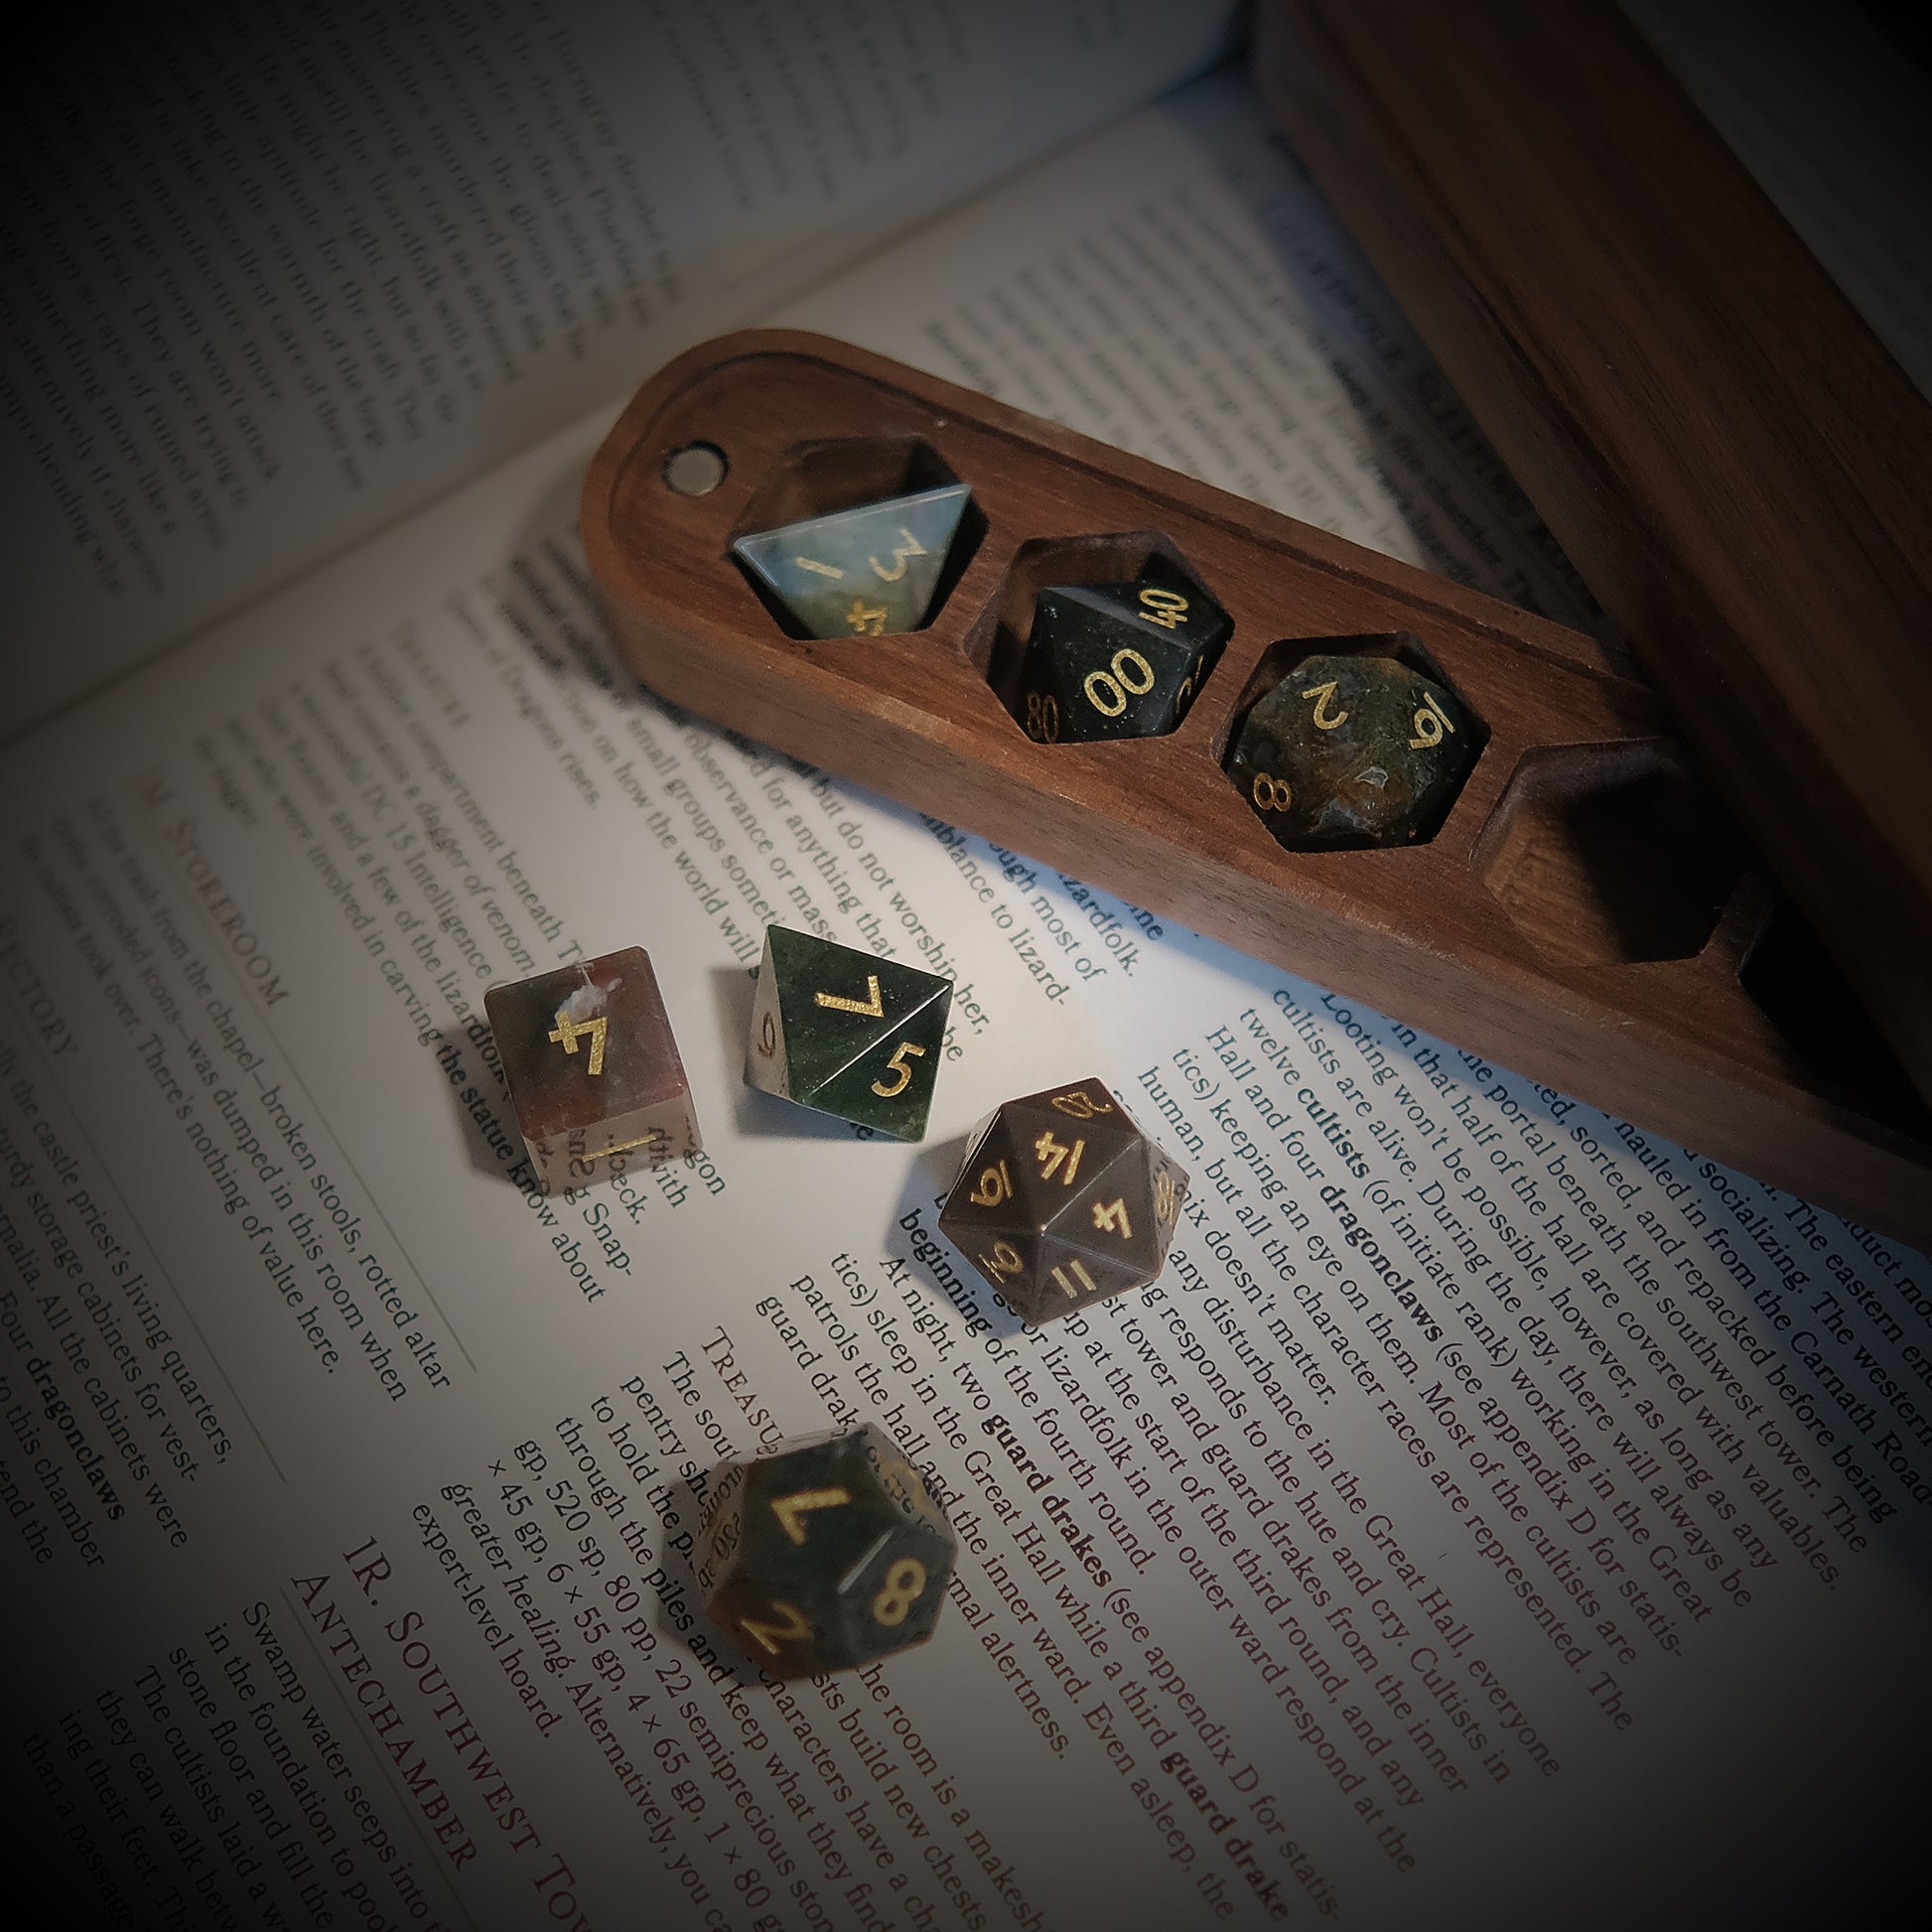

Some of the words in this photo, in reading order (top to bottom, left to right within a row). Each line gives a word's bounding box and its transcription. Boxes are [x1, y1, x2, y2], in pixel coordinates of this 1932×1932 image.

[795, 556, 843, 579] 1
[869, 527, 926, 582] 3
[847, 598, 888, 636] 4
[1138, 588, 1188, 629] 40
[1027, 691, 1059, 743] 80
[1084, 648, 1155, 717] 00
[1302, 681, 1348, 730] 2
[1254, 771, 1291, 811] 8
[990, 902, 1015, 930] to
[1007, 926, 1071, 1007] lizard-
[1029, 895, 1082, 956] most
[1073, 956, 1109, 983] of
[548, 1011, 609, 1075] 4
[813, 975, 885, 1019] 7
[953, 982, 991, 1035] her,
[871, 1041, 925, 1098] 5
[1050, 1091, 1114, 1120] 20
[379, 959, 445, 1047] carving
[435, 1043, 467, 1087] the
[455, 1086, 515, 1162] statue
[504, 1161, 561, 1228] know
[550, 1232, 608, 1305] about
[583, 1134, 658, 1163] 1
[1035, 1131, 1085, 1185] 14
[1092, 1197, 1133, 1239] 4
[1204, 1025, 1257, 1082] Hall
[1244, 1084, 1294, 1132] and
[1279, 1129, 1326, 1181] four
[1318, 1184, 1446, 1343] dragonclaws
[1435, 1341, 1483, 1396] (see
[1239, 1008, 1302, 1086] twelve
[1297, 1087, 1371, 1180] cultists
[1361, 1178, 1407, 1215] (of
[1389, 1211, 1461, 1301] initiate
[1453, 1301, 1519, 1368] rank)
[185, 1121, 251, 1216] nothing
[240, 1214, 275, 1241] of
[258, 1239, 305, 1309] value
[295, 1305, 340, 1375] here.
[310, 1173, 362, 1254] stools,
[356, 1253, 420, 1331] rotted
[404, 1330, 452, 1390] altar
[581, 1201, 632, 1277] Snap-
[1050, 1259, 1098, 1300] 11
[1393, 1082, 1450, 1152] won't
[1441, 1146, 1472, 1184] be
[1459, 1184, 1550, 1292] possible,
[1547, 1285, 1638, 1400] however,
[1697, 1162, 1812, 1296] socializing.
[1809, 1290, 1856, 1346] The
[32, 1121, 79, 1188] castle
[65, 1188, 130, 1278] priest's
[120, 1273, 174, 1351] living
[160, 1349, 232, 1465] quarters,
[1481, 1083, 1558, 1159] portal
[1545, 1153, 1629, 1256] beneath
[1621, 1253, 1661, 1297] the
[1654, 1297, 1765, 1422] southwest
[1756, 1419, 1823, 1499] tower.
[1821, 1493, 1868, 1554] The
[1679, 1197, 1708, 1231] in
[1702, 1226, 1757, 1292] from
[1752, 1288, 1793, 1332] the
[1789, 1330, 1878, 1437] Carnath
[700, 1324, 785, 1452] TREASU
[897, 1206, 994, 1339] beginning
[984, 1336, 1020, 1366] of
[1003, 1363, 1039, 1409] the
[1032, 1407, 1098, 1491] fourth
[1087, 1490, 1158, 1576] round.
[5, 1404, 42, 1456] this
[33, 1457, 106, 1569] chamber
[25, 1356, 127, 1522] dragonclaws
[512, 1439, 548, 1482] gp,
[545, 1478, 592, 1533] 520
[771, 1487, 852, 1547] 7
[1167, 1249, 1210, 1294] any
[1202, 1296, 1313, 1442] disturbance
[1306, 1438, 1335, 1472] in
[1329, 1469, 1368, 1515] the
[1364, 1514, 1428, 1592] Great
[1416, 1586, 1476, 1659] Hall,
[1467, 1659, 1561, 1778] everyone
[577, 1535, 607, 1578] sp,
[604, 1574, 641, 1614] 80
[873, 1558, 926, 1626] 8
[1119, 1317, 1178, 1389] tower
[1170, 1392, 1221, 1443] and
[1200, 1443, 1276, 1520] guard
[1261, 1519, 1332, 1608] drakes
[1323, 1605, 1379, 1676] from
[1374, 1673, 1413, 1721] the
[1406, 1718, 1468, 1793] inner
[411, 1503, 516, 1652] expert-level
[497, 1647, 564, 1739] hoard.
[554, 1416, 629, 1522] through
[619, 1520, 654, 1567] the
[639, 1566, 698, 1633] piles
[682, 1632, 740, 1688] and
[719, 1680, 769, 1752] keep
[763, 1751, 817, 1824] what
[805, 1821, 854, 1881] they
[620, 1615, 658, 1662] pp,
[741, 1598, 816, 1655] 2
[980, 1413, 1055, 1495] guard
[1040, 1494, 1114, 1589] drakes
[1102, 1587, 1151, 1644] (see
[1143, 1645, 1237, 1768] appendix
[1227, 1762, 1260, 1793] D
[1248, 1794, 1287, 1836] for
[1279, 1840, 1339, 1921] statis-
[289, 1575, 478, 1872] ANTECHAMBER
[342, 1534, 392, 1607] 1R.
[382, 1610, 543, 1854] SOUTHWEST
[439, 1483, 514, 1572] greater
[500, 1573, 578, 1680] healing.
[564, 1682, 678, 1855] Alternatively,
[663, 1852, 712, 1907] you
[653, 1658, 693, 1700] 22
[980, 1631, 1070, 1760] alertness.
[132, 1664, 172, 1724] The
[163, 1725, 226, 1825] cultists
[215, 1820, 265, 1880] laid
[246, 1881, 268, 1903] a
[168, 1646, 218, 1721] stone
[207, 1719, 256, 1784] floor
[245, 1788, 294, 1843] and
[275, 1840, 317, 1883] fill
[299, 1881, 335, 1930] the
[241, 1600, 308, 1705] Swamp
[301, 1704, 353, 1781] water
[343, 1784, 398, 1864] seeps
[387, 1861, 429, 1920] into
[678, 1700, 797, 1877] semiprecious
